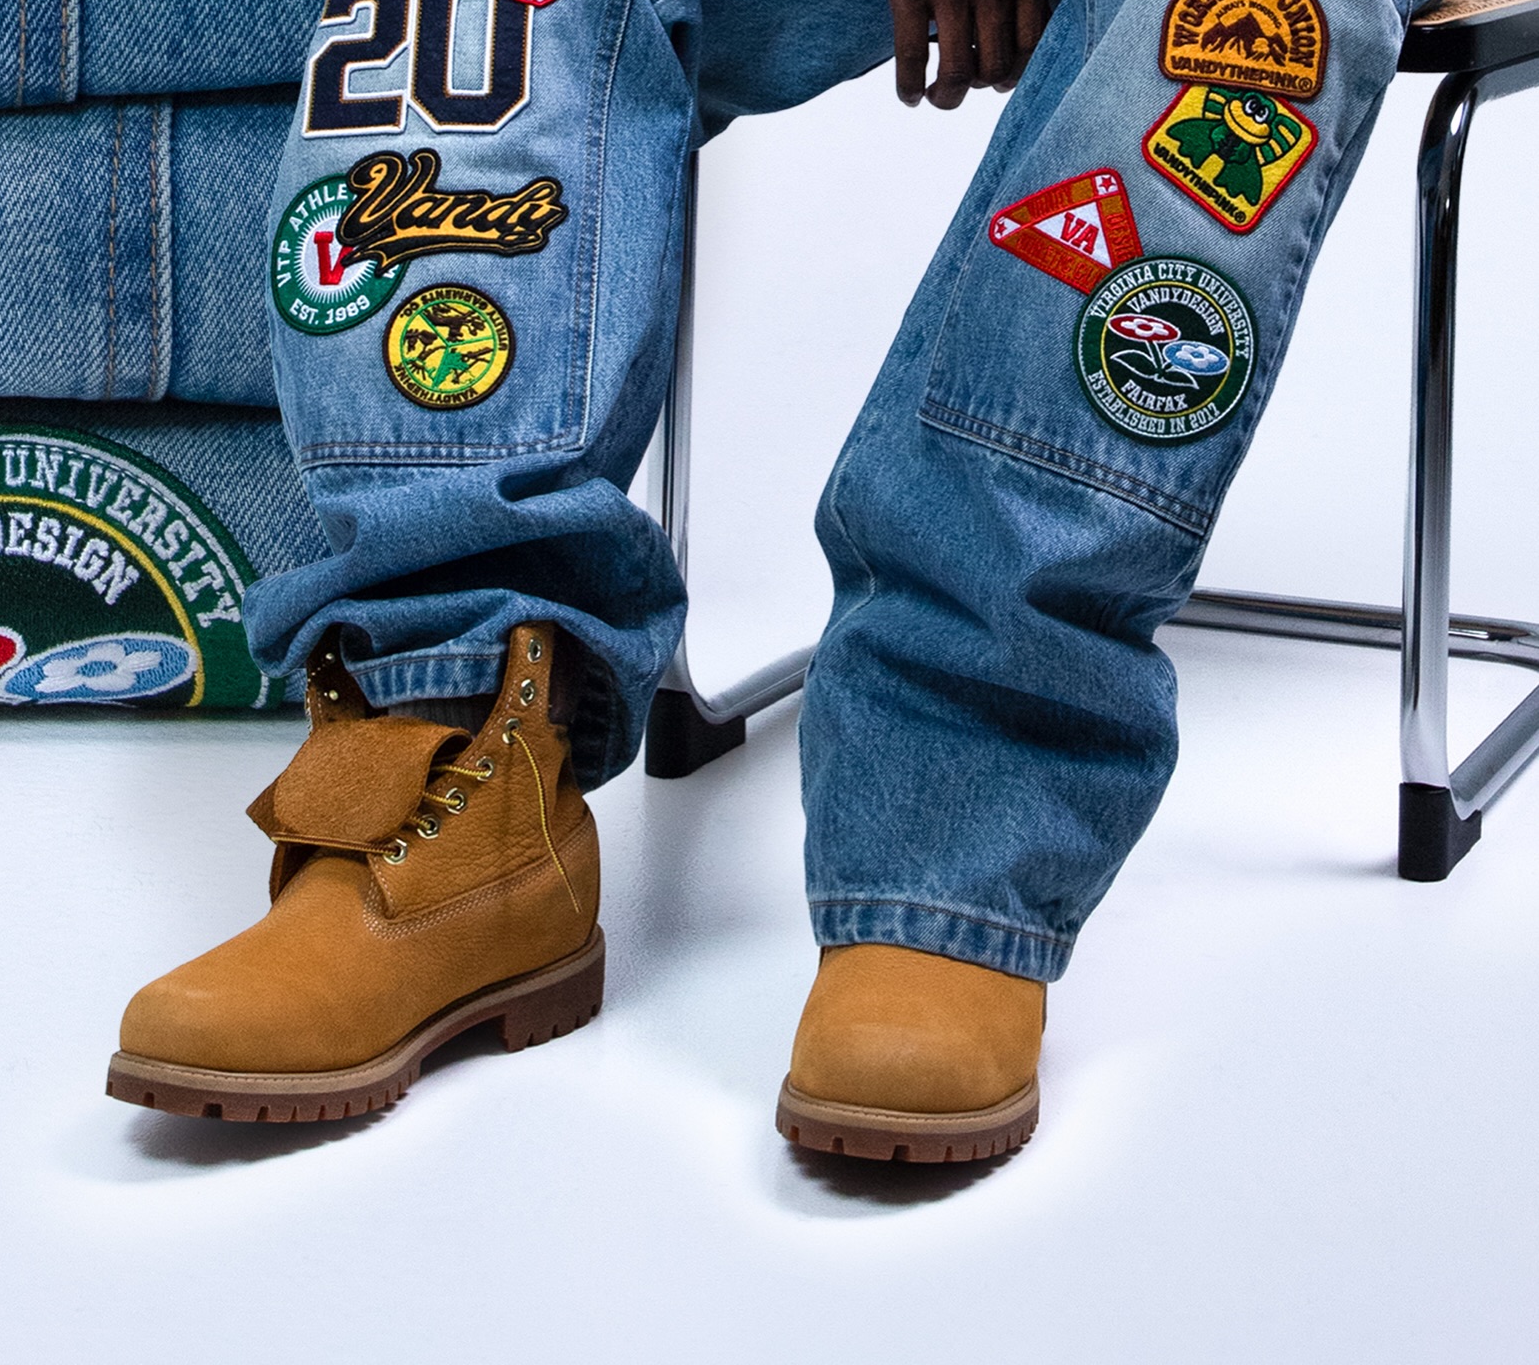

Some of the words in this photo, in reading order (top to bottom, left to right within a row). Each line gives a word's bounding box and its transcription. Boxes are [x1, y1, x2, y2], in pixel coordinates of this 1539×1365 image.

[1215, 0, 1247, 19] ALWAYS
[338, 150, 566, 249] Vandy
[276, 240, 293, 288] VTP
[289, 183, 358, 232] ATHLE
[1060, 210, 1100, 256] VA
[314, 231, 355, 286] V
[289, 298, 319, 325] EST.
[324, 294, 370, 325] 1989
[420, 289, 488, 311] GARMENTS
[1089, 264, 1155, 319] VIRGINIA
[1157, 263, 1198, 282] CITY
[1198, 272, 1250, 360] UNIVERSITY
[1126, 287, 1225, 336] VANDYDESIGN
[394, 362, 479, 403] VANDYTHEPINK
[1087, 369, 1166, 434] ESTABLISHED
[1169, 417, 1187, 432] IN
[1188, 401, 1221, 430] 2017
[1120, 379, 1189, 412] FAIRFAX
[3, 445, 241, 629] UNIVERSITY
